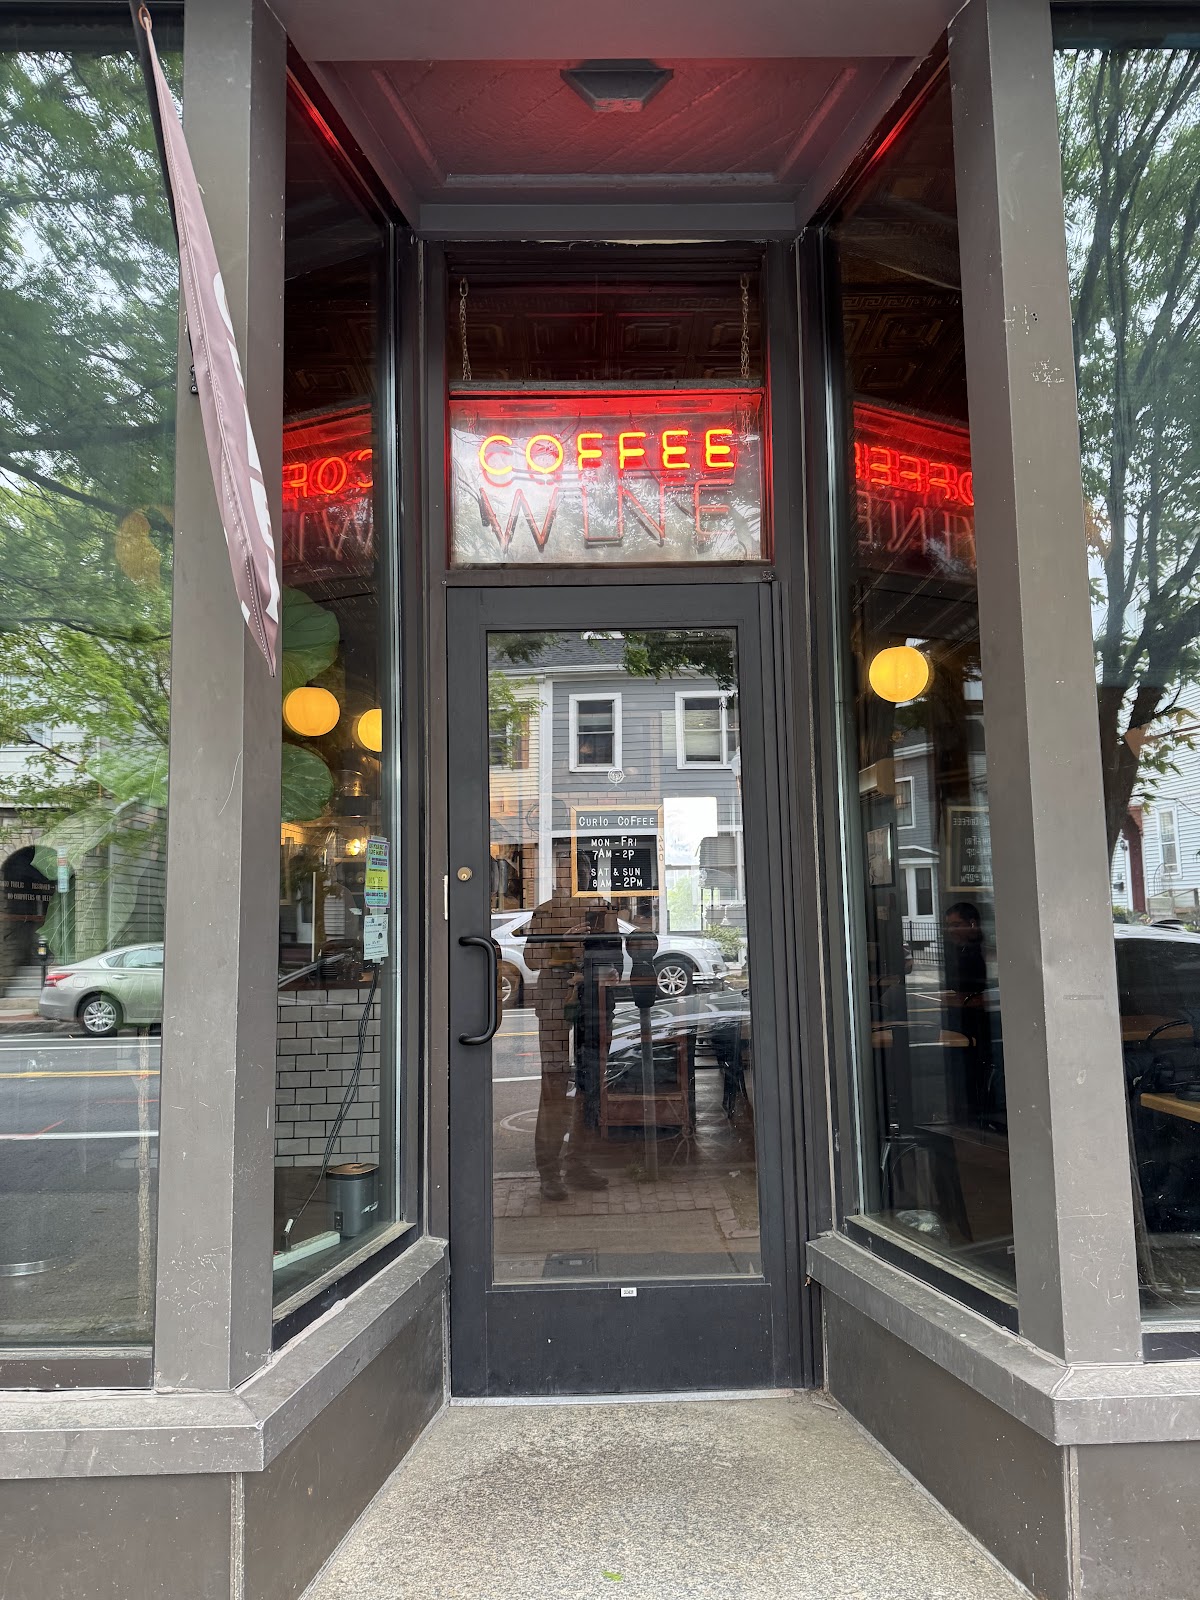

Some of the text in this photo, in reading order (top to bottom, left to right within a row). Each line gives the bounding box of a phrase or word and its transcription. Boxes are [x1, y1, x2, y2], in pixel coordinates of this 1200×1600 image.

[478, 428, 735, 476] COFFEE
[478, 480, 735, 549] WINE
[617, 815, 655, 826] COFFEE
[590, 867, 641, 877] SAT & SUN
[623, 877, 643, 888] 2PM
